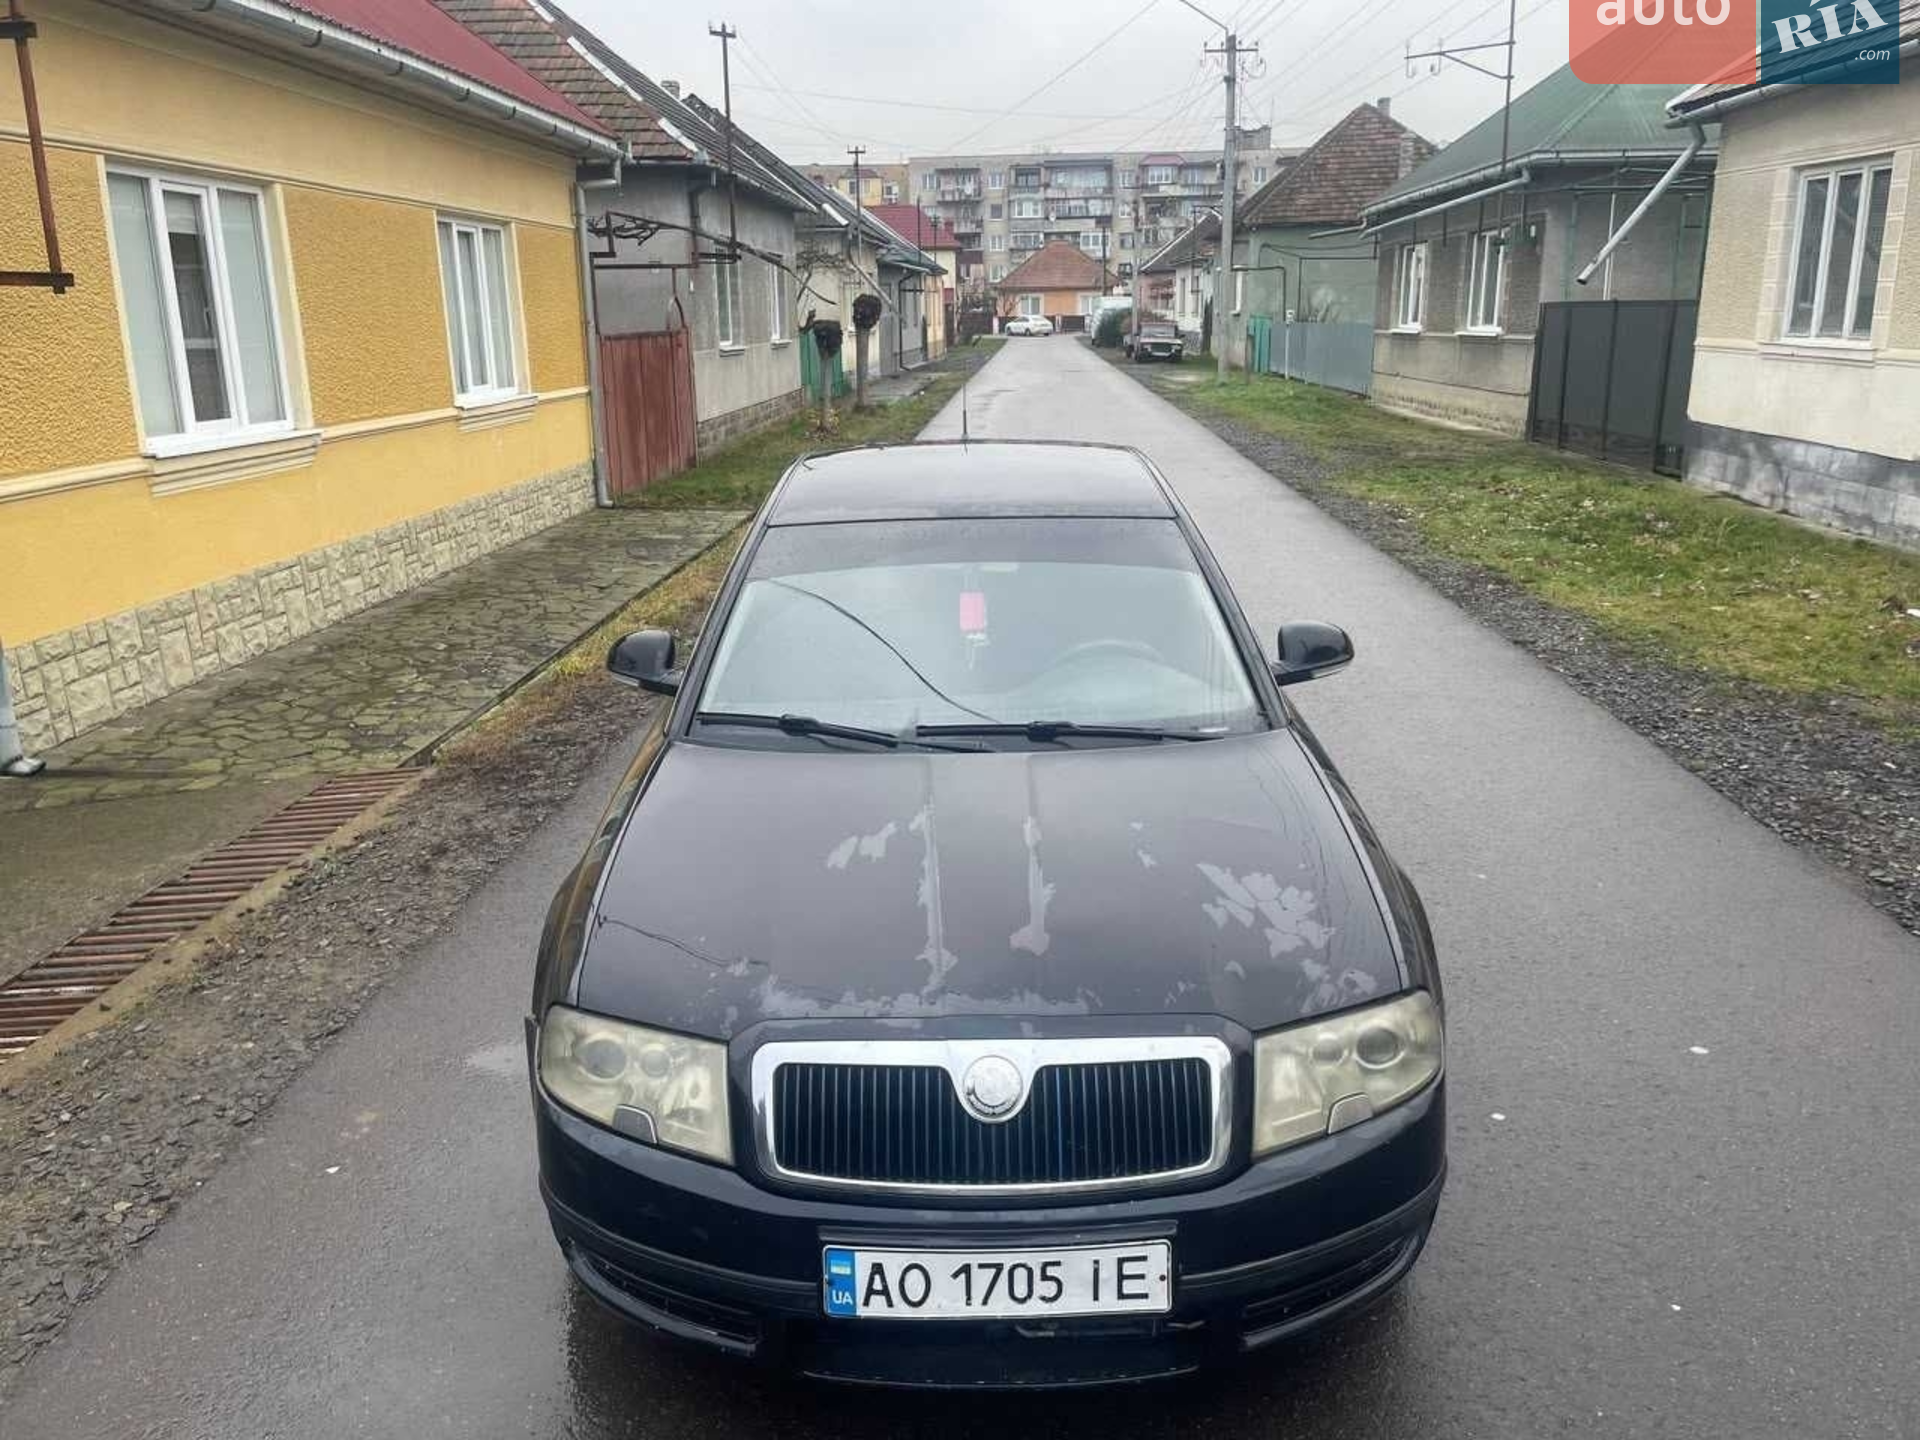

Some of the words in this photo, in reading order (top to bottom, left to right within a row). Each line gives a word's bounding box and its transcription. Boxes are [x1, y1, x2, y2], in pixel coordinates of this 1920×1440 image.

[832, 1289, 854, 1305] UA
[862, 1262, 931, 1308] AO
[950, 1260, 1063, 1306] 1705
[1092, 1255, 1149, 1302] IE
